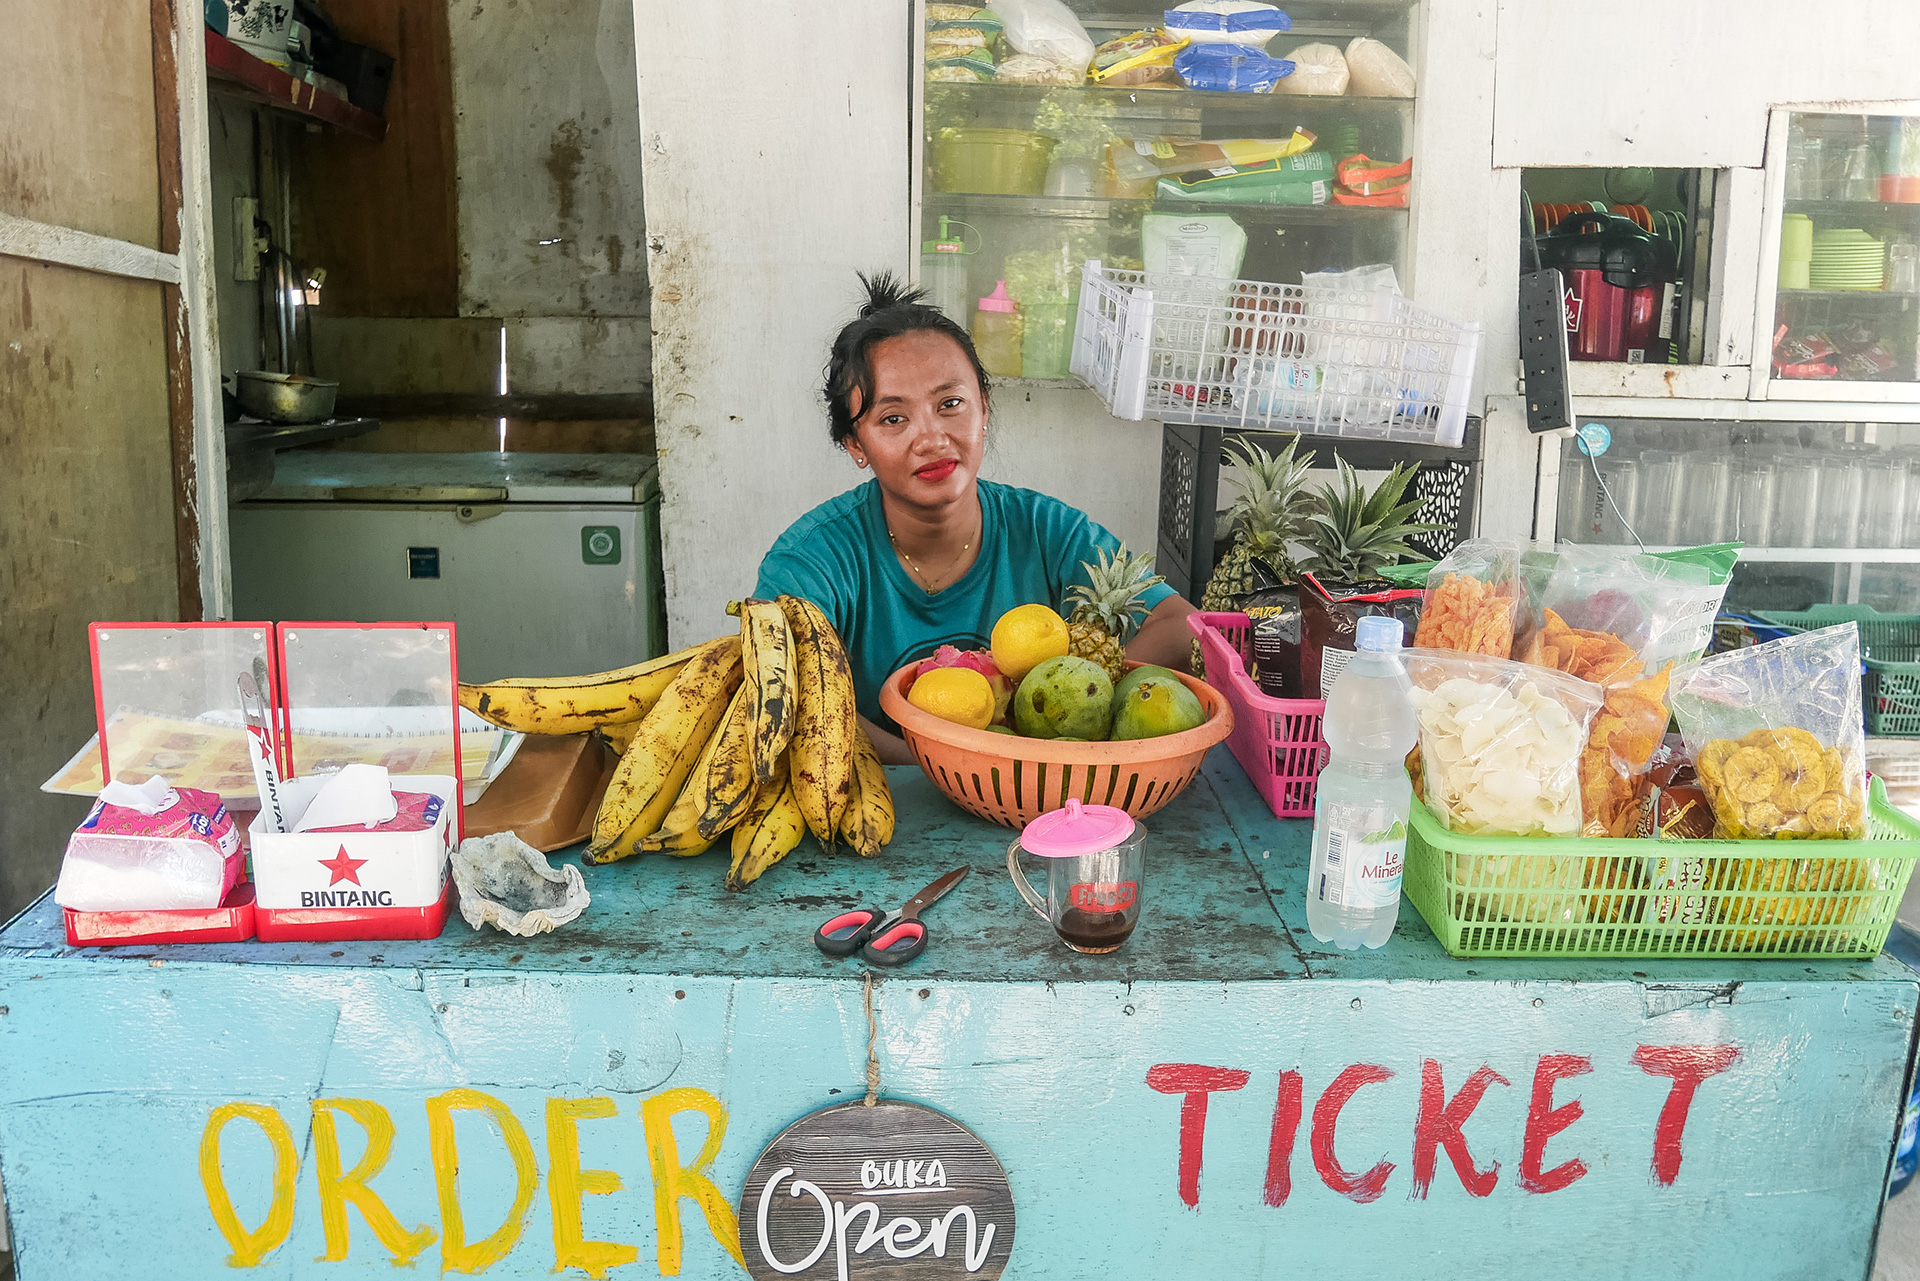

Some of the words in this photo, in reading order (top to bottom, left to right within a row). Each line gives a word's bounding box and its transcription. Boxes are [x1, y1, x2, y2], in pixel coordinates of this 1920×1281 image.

[1385, 851, 1398, 866] Le
[300, 890, 392, 907] BINTANG
[199, 1087, 748, 1280] ORDER
[1144, 1042, 1743, 1214] TICKET
[860, 1158, 947, 1190] BUKA
[757, 1166, 996, 1281] Open
